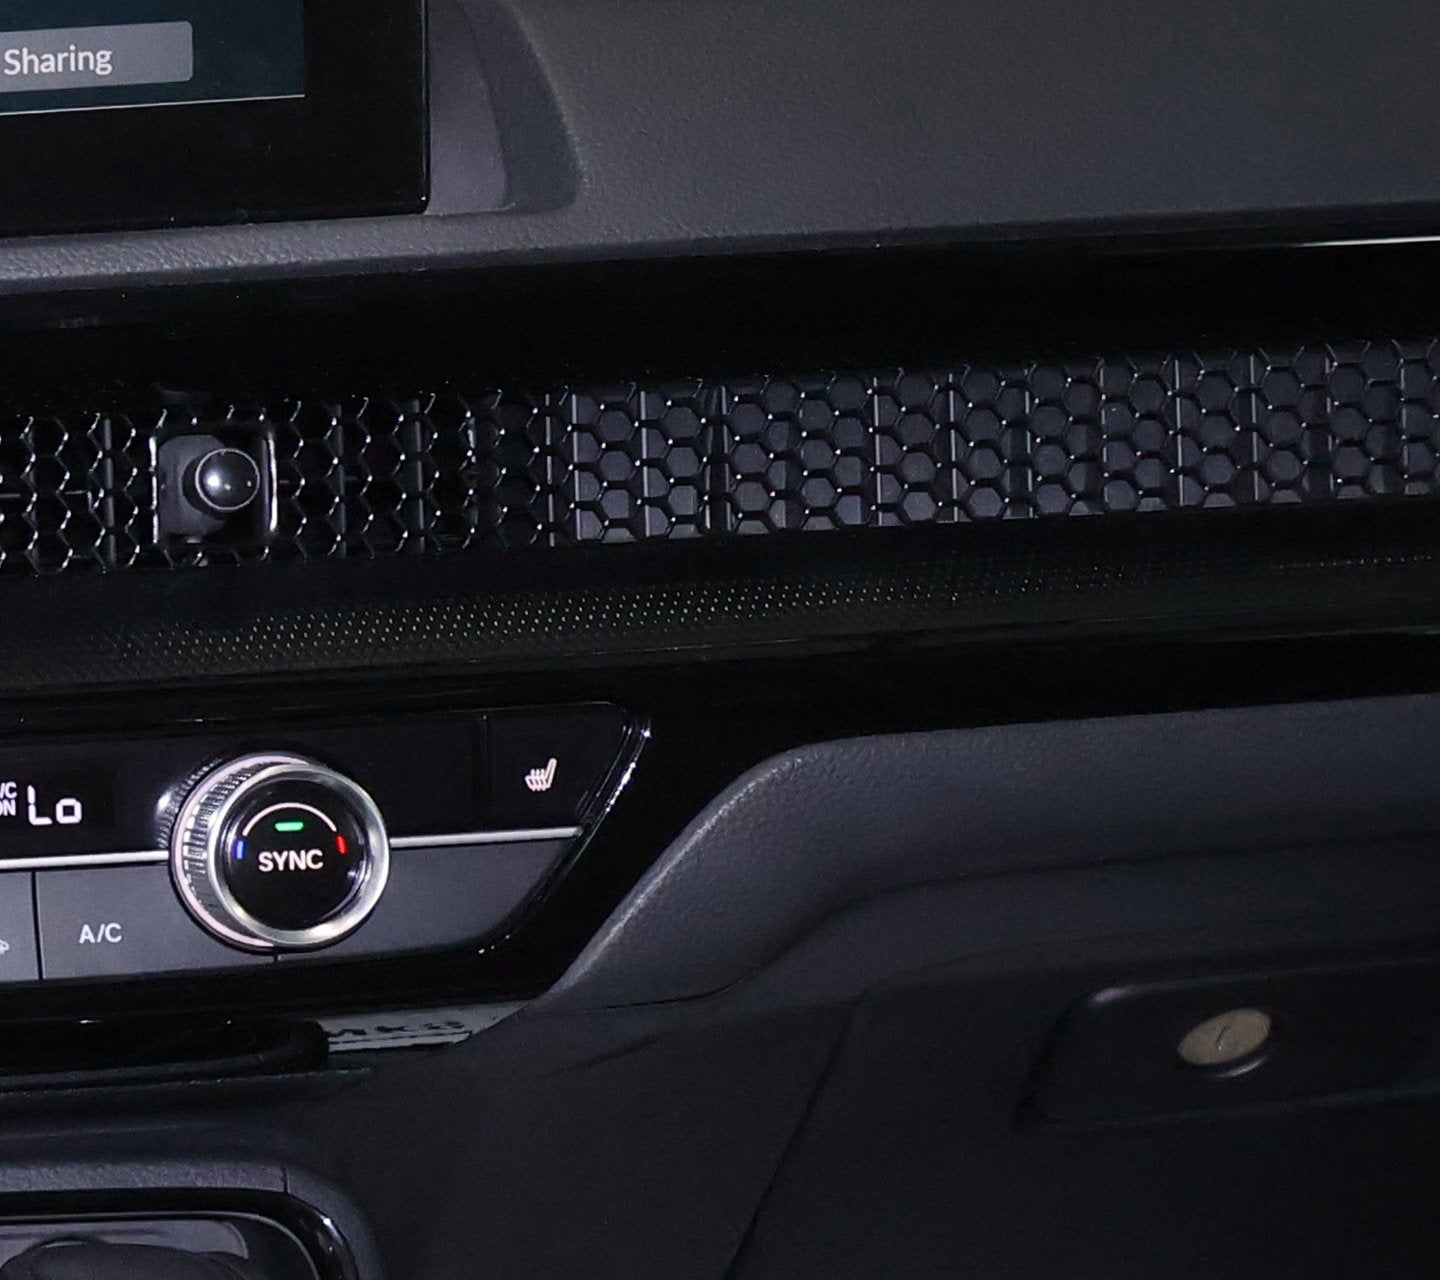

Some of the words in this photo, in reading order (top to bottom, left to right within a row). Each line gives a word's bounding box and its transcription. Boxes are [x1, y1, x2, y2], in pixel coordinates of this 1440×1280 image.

[4, 44, 112, 75] Sharing
[258, 849, 325, 873] SYNC
[78, 922, 123, 944] A/C
